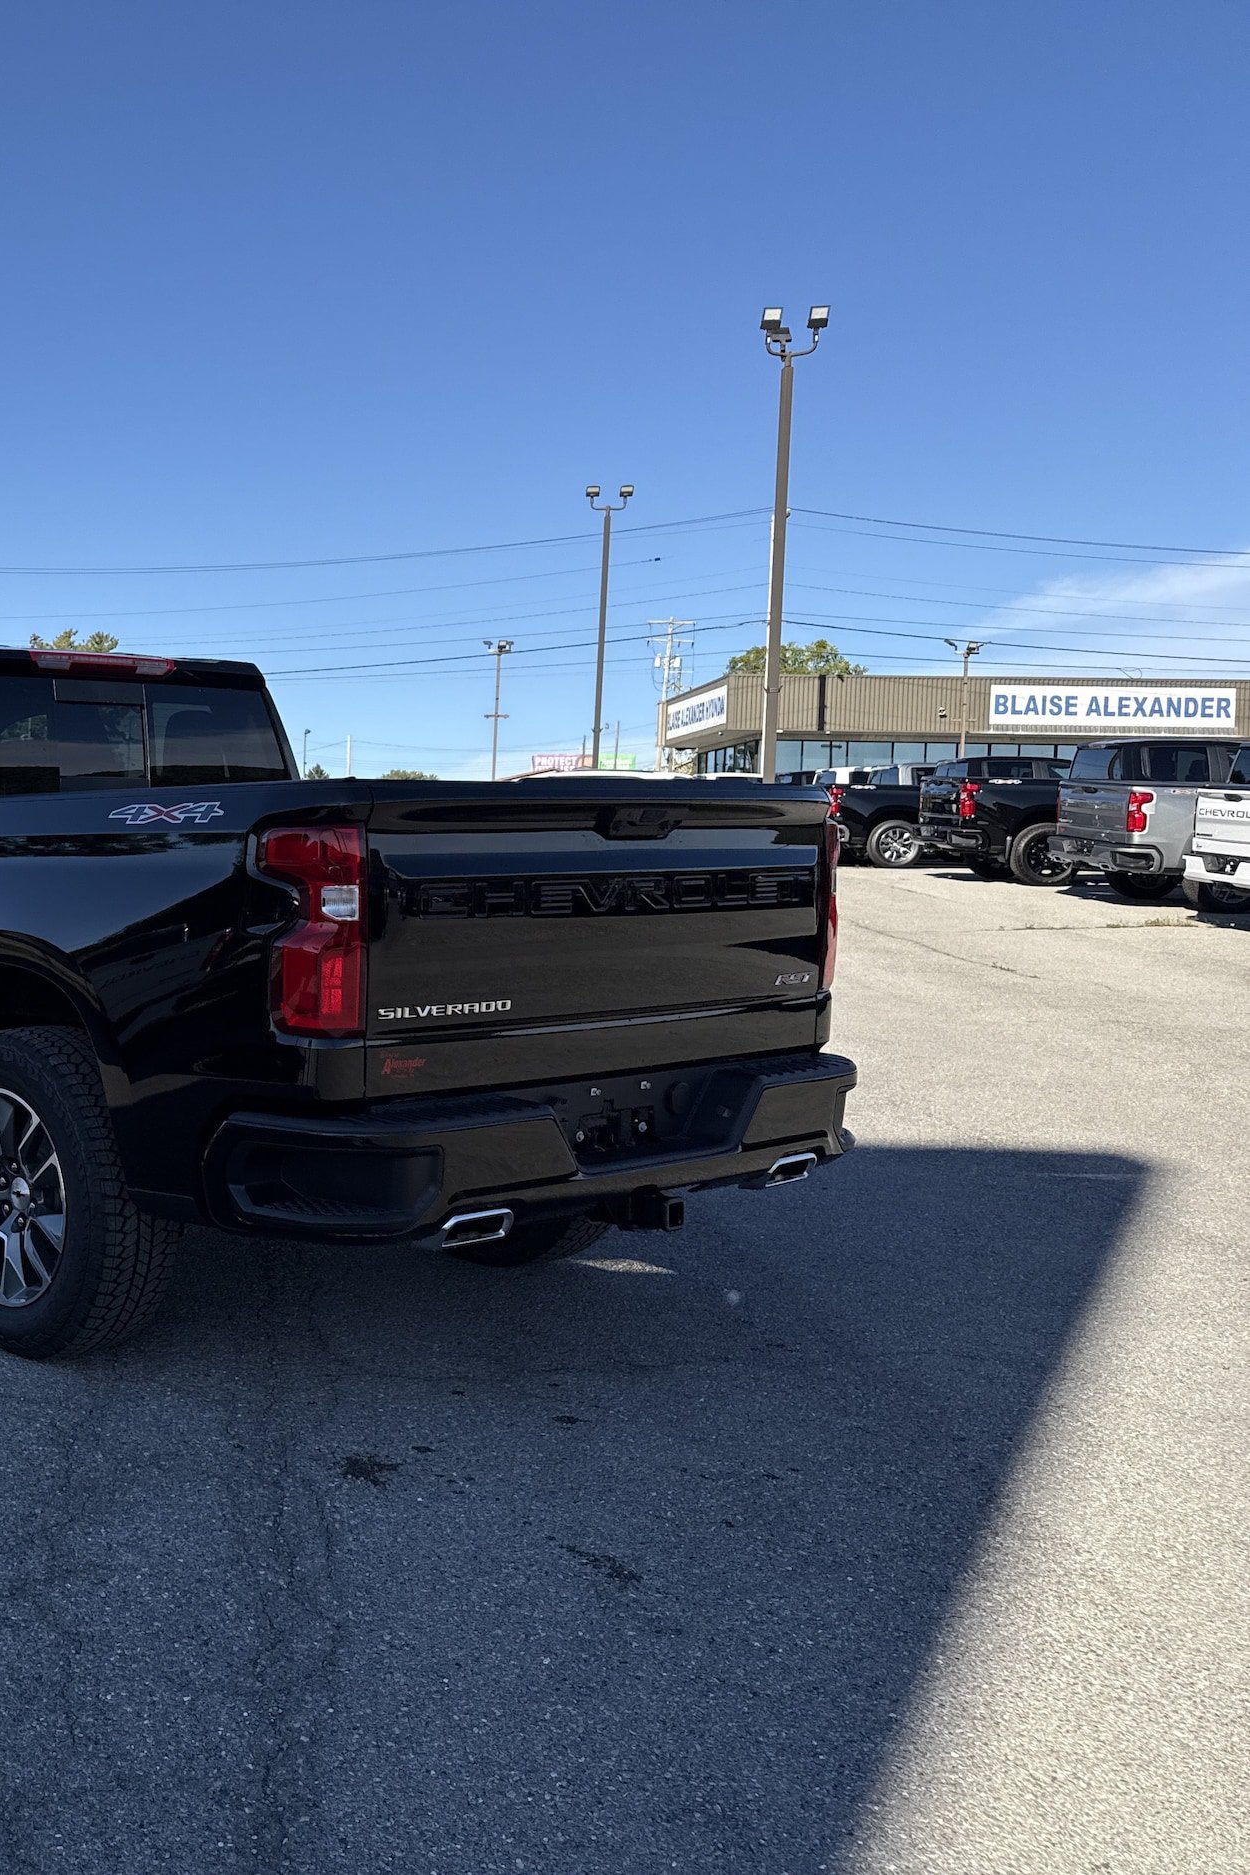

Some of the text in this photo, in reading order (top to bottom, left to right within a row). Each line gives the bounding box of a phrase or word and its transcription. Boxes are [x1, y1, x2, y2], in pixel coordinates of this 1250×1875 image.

[994, 694, 1231, 719] BLAISE ALEXANDER
[534, 756, 577, 766] PROTECT
[418, 871, 811, 919] CHEVROLET
[377, 999, 512, 1020] SILVERADO
